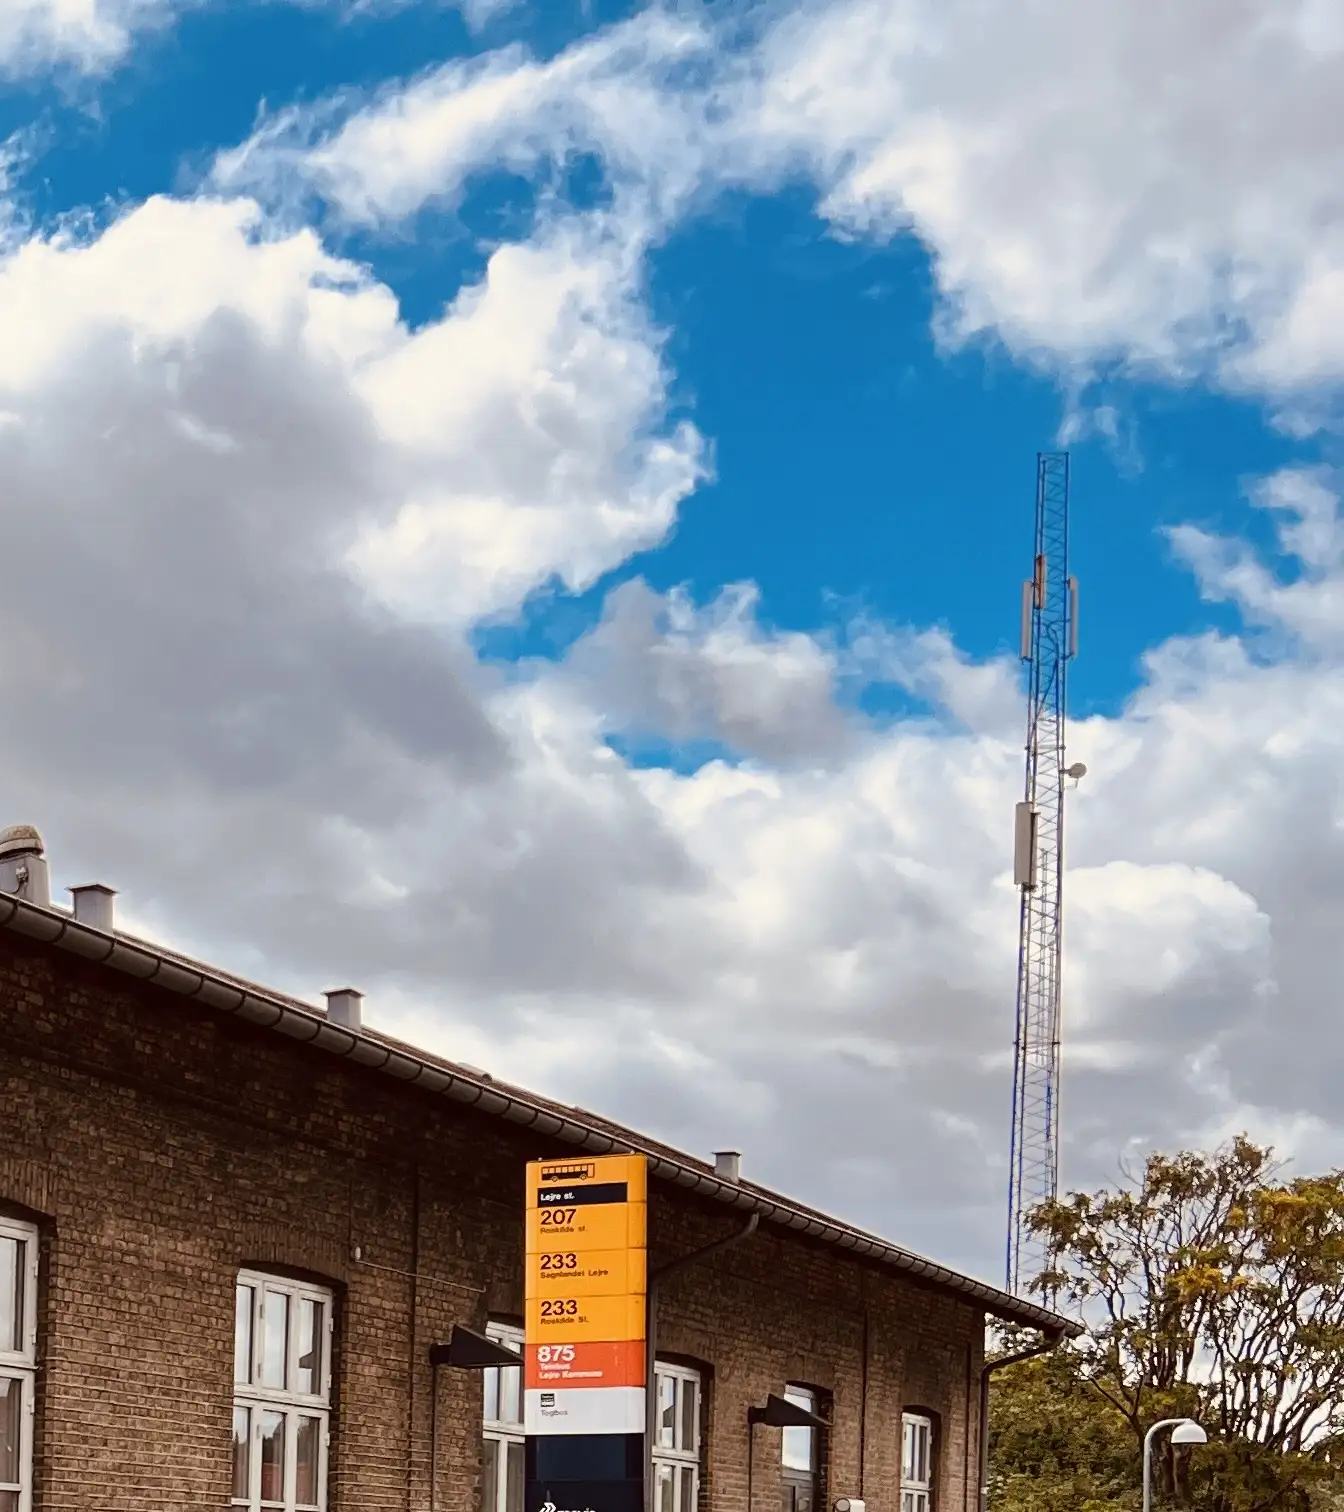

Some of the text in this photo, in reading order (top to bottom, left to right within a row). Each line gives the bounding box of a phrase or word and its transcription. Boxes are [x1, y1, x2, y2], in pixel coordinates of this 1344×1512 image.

[540, 1193, 562, 1202] Lejre
[540, 1208, 577, 1225] 207
[540, 1253, 577, 1271] 233
[540, 1299, 578, 1317] 233
[537, 1344, 576, 1363] 875
